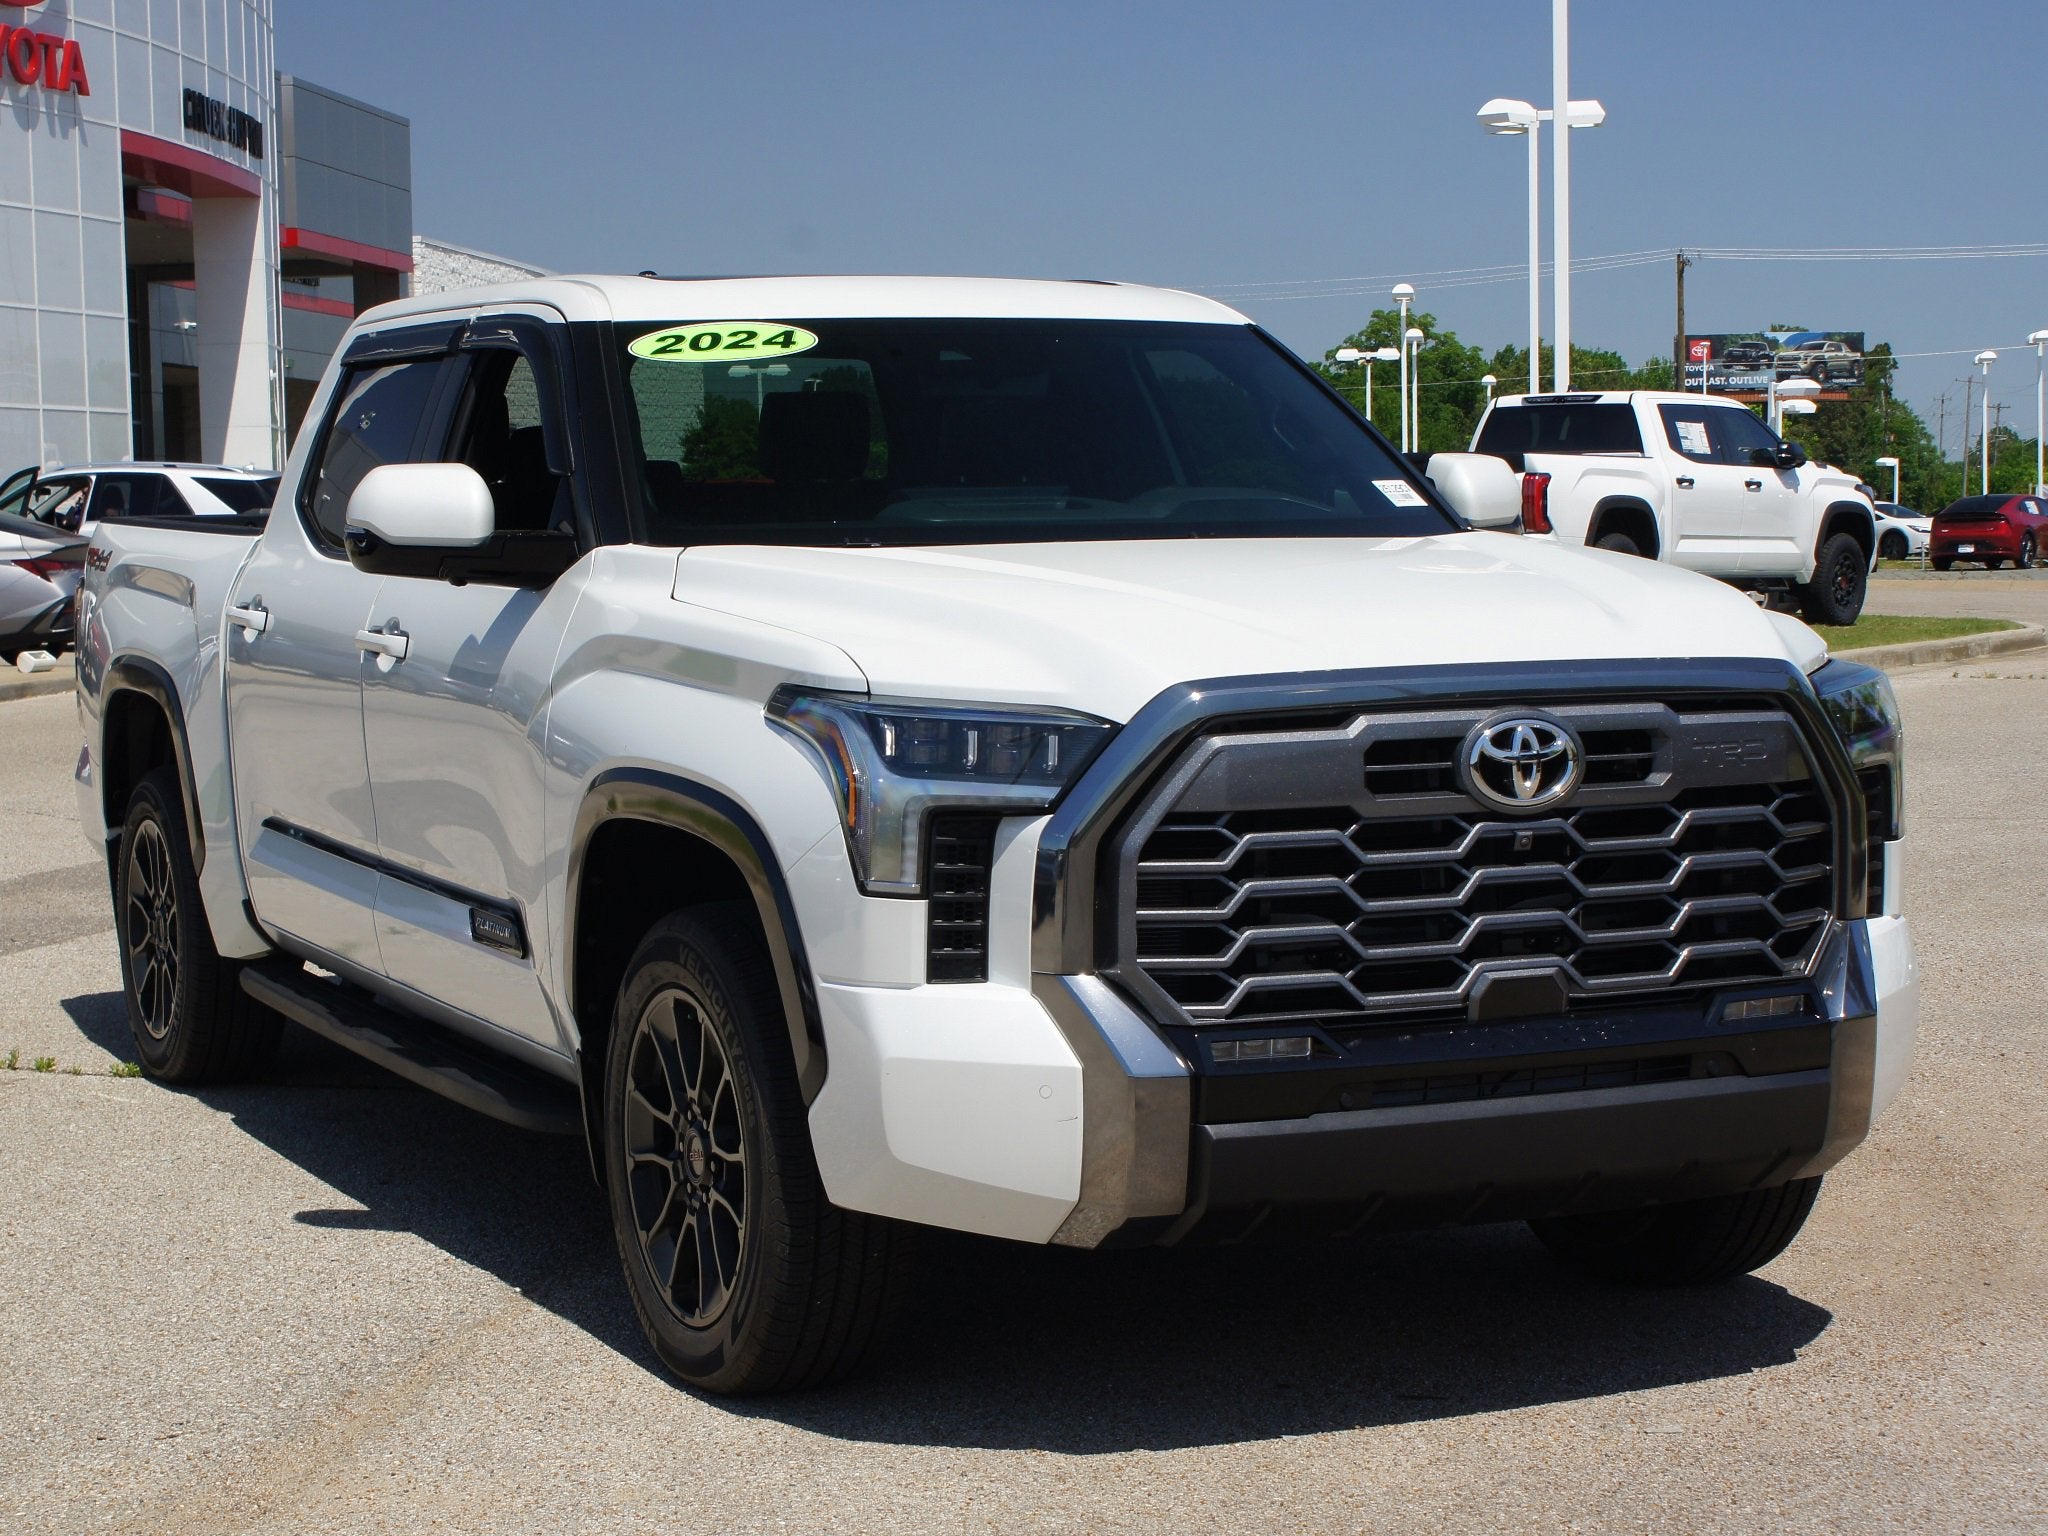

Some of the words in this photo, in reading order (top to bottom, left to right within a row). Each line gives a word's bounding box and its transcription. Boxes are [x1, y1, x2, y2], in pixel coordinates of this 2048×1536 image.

[650, 330, 796, 355] 2024
[1729, 376, 1769, 385] OUTLIVE
[1691, 739, 1767, 768] TRD
[475, 917, 511, 939] PLATINUM
[679, 943, 743, 1057] VELOCITY
